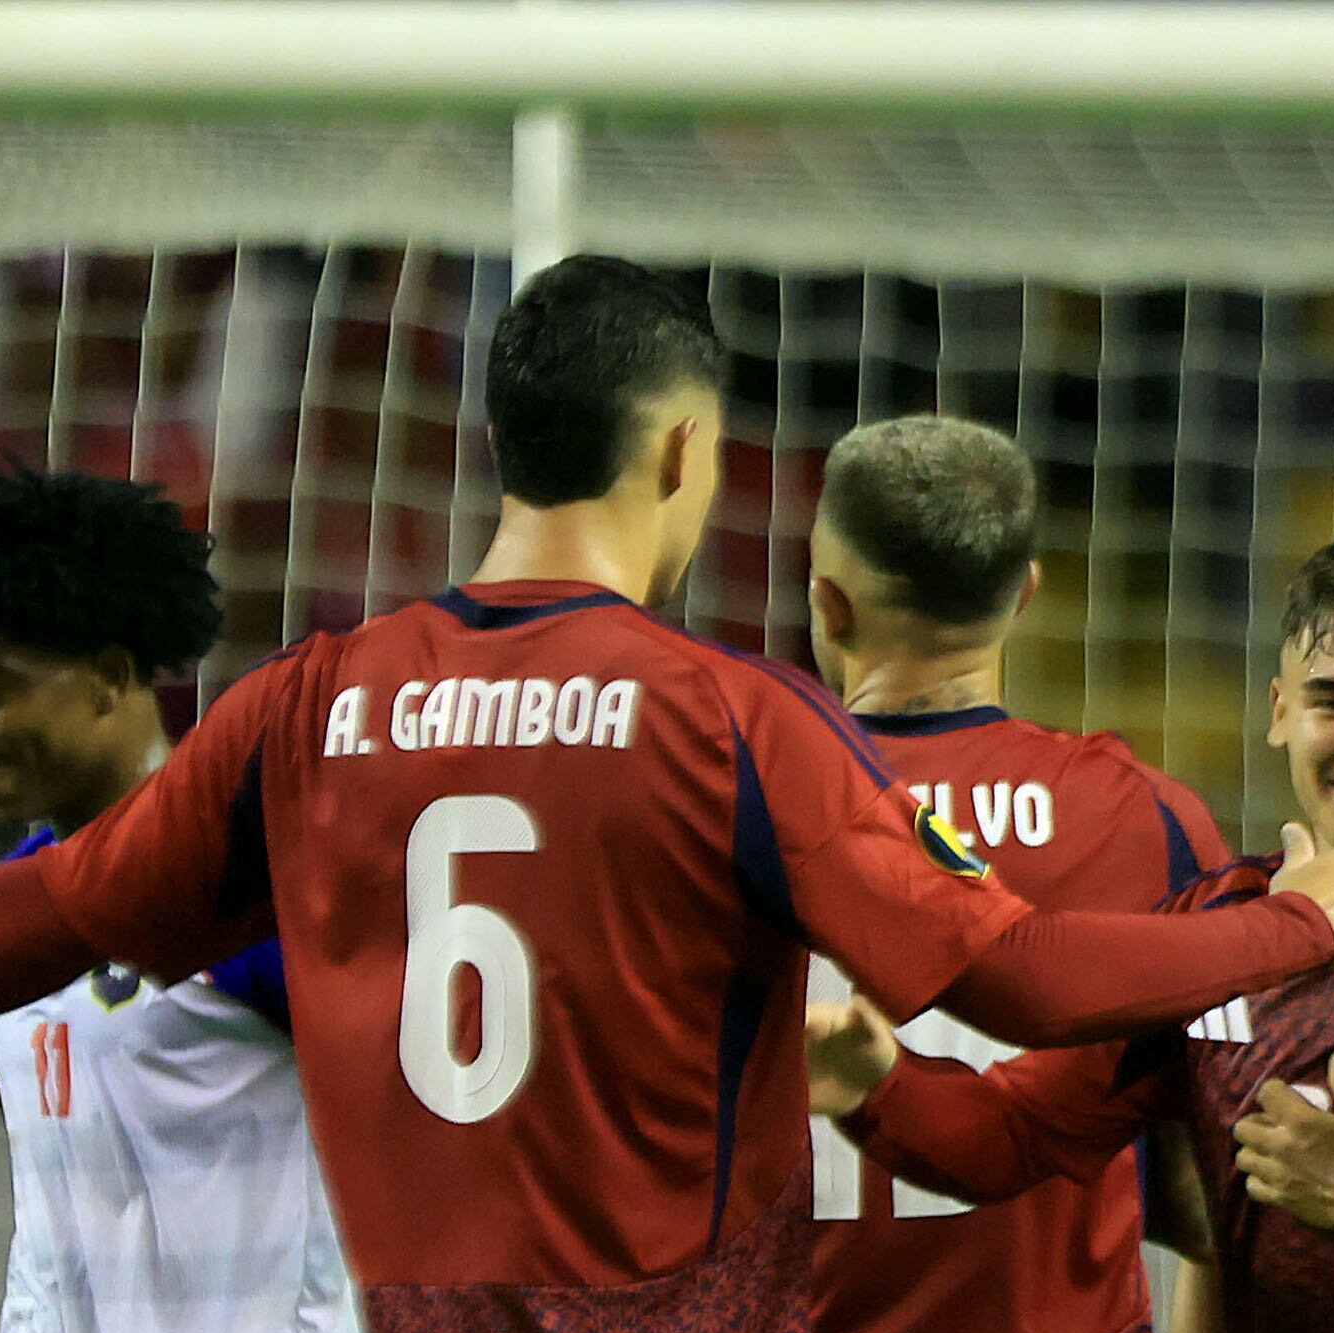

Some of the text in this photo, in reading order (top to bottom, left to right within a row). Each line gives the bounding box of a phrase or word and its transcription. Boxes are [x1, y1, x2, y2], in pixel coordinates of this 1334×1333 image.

[323, 675, 640, 757] A. GAMBOA
[907, 780, 1055, 848] LVO
[398, 795, 538, 1124] 6
[31, 1023, 71, 1117] 11
